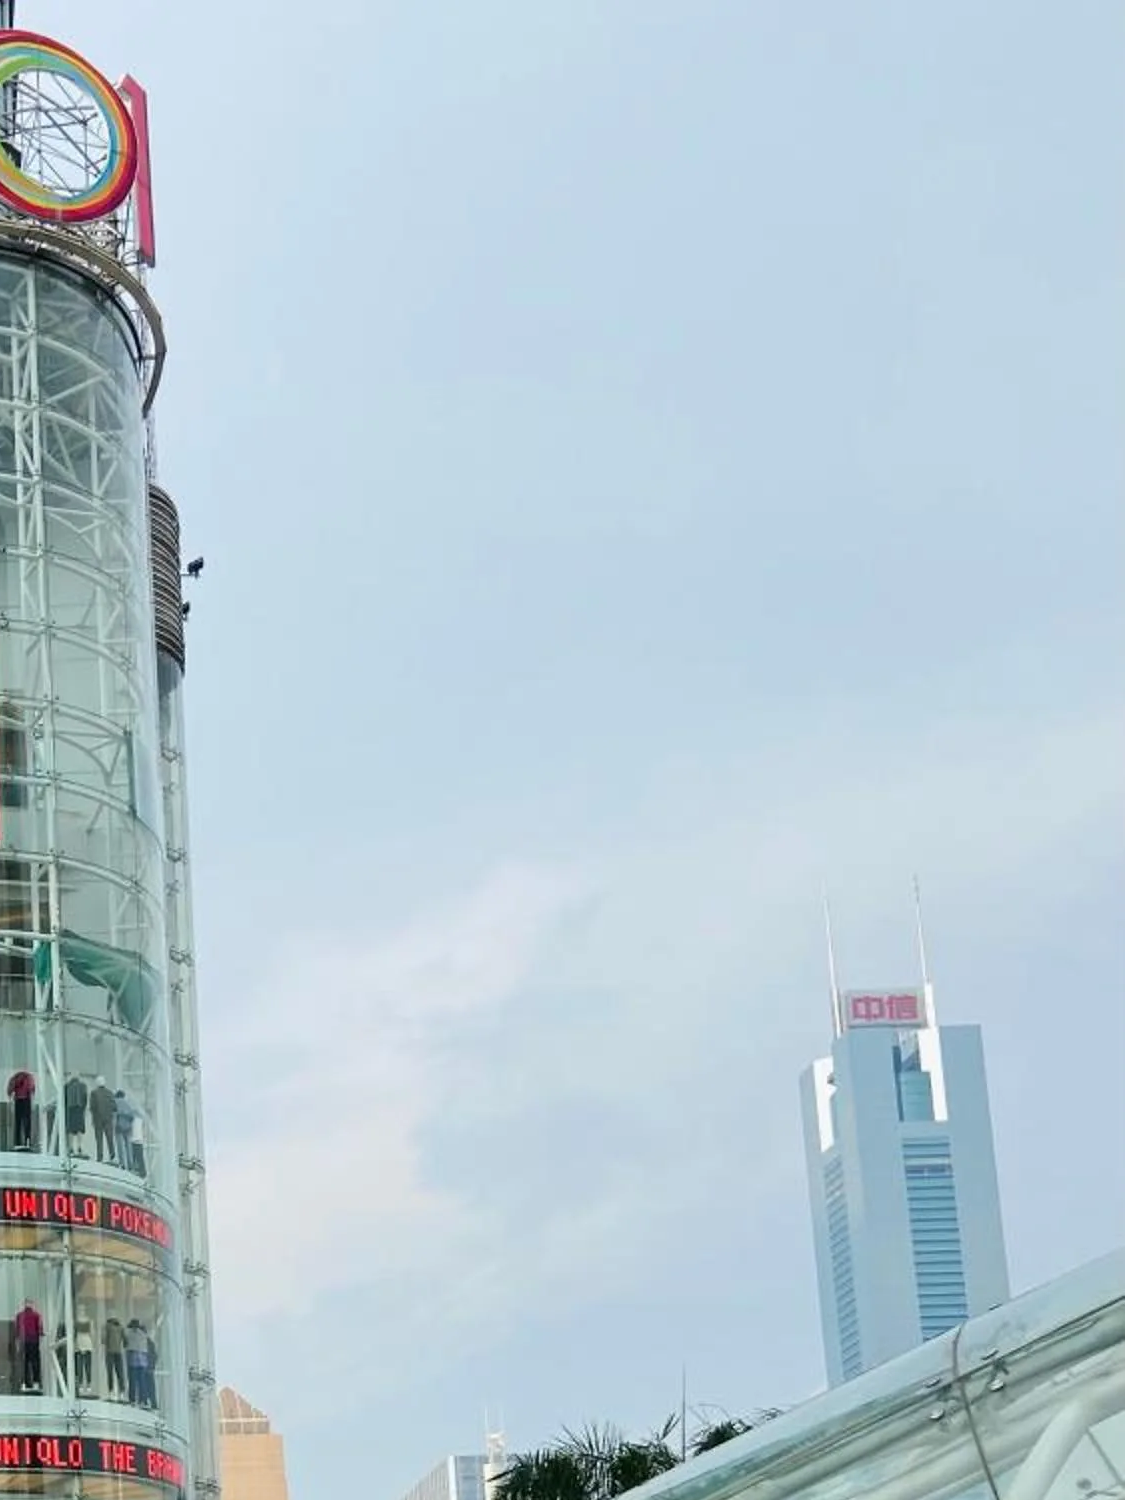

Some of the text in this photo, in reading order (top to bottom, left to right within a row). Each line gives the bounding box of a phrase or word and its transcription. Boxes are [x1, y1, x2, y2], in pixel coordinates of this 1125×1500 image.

[851, 994, 919, 1022] 中信
[5, 1189, 98, 1225] UNIQLO
[98, 1441, 138, 1473] THE
